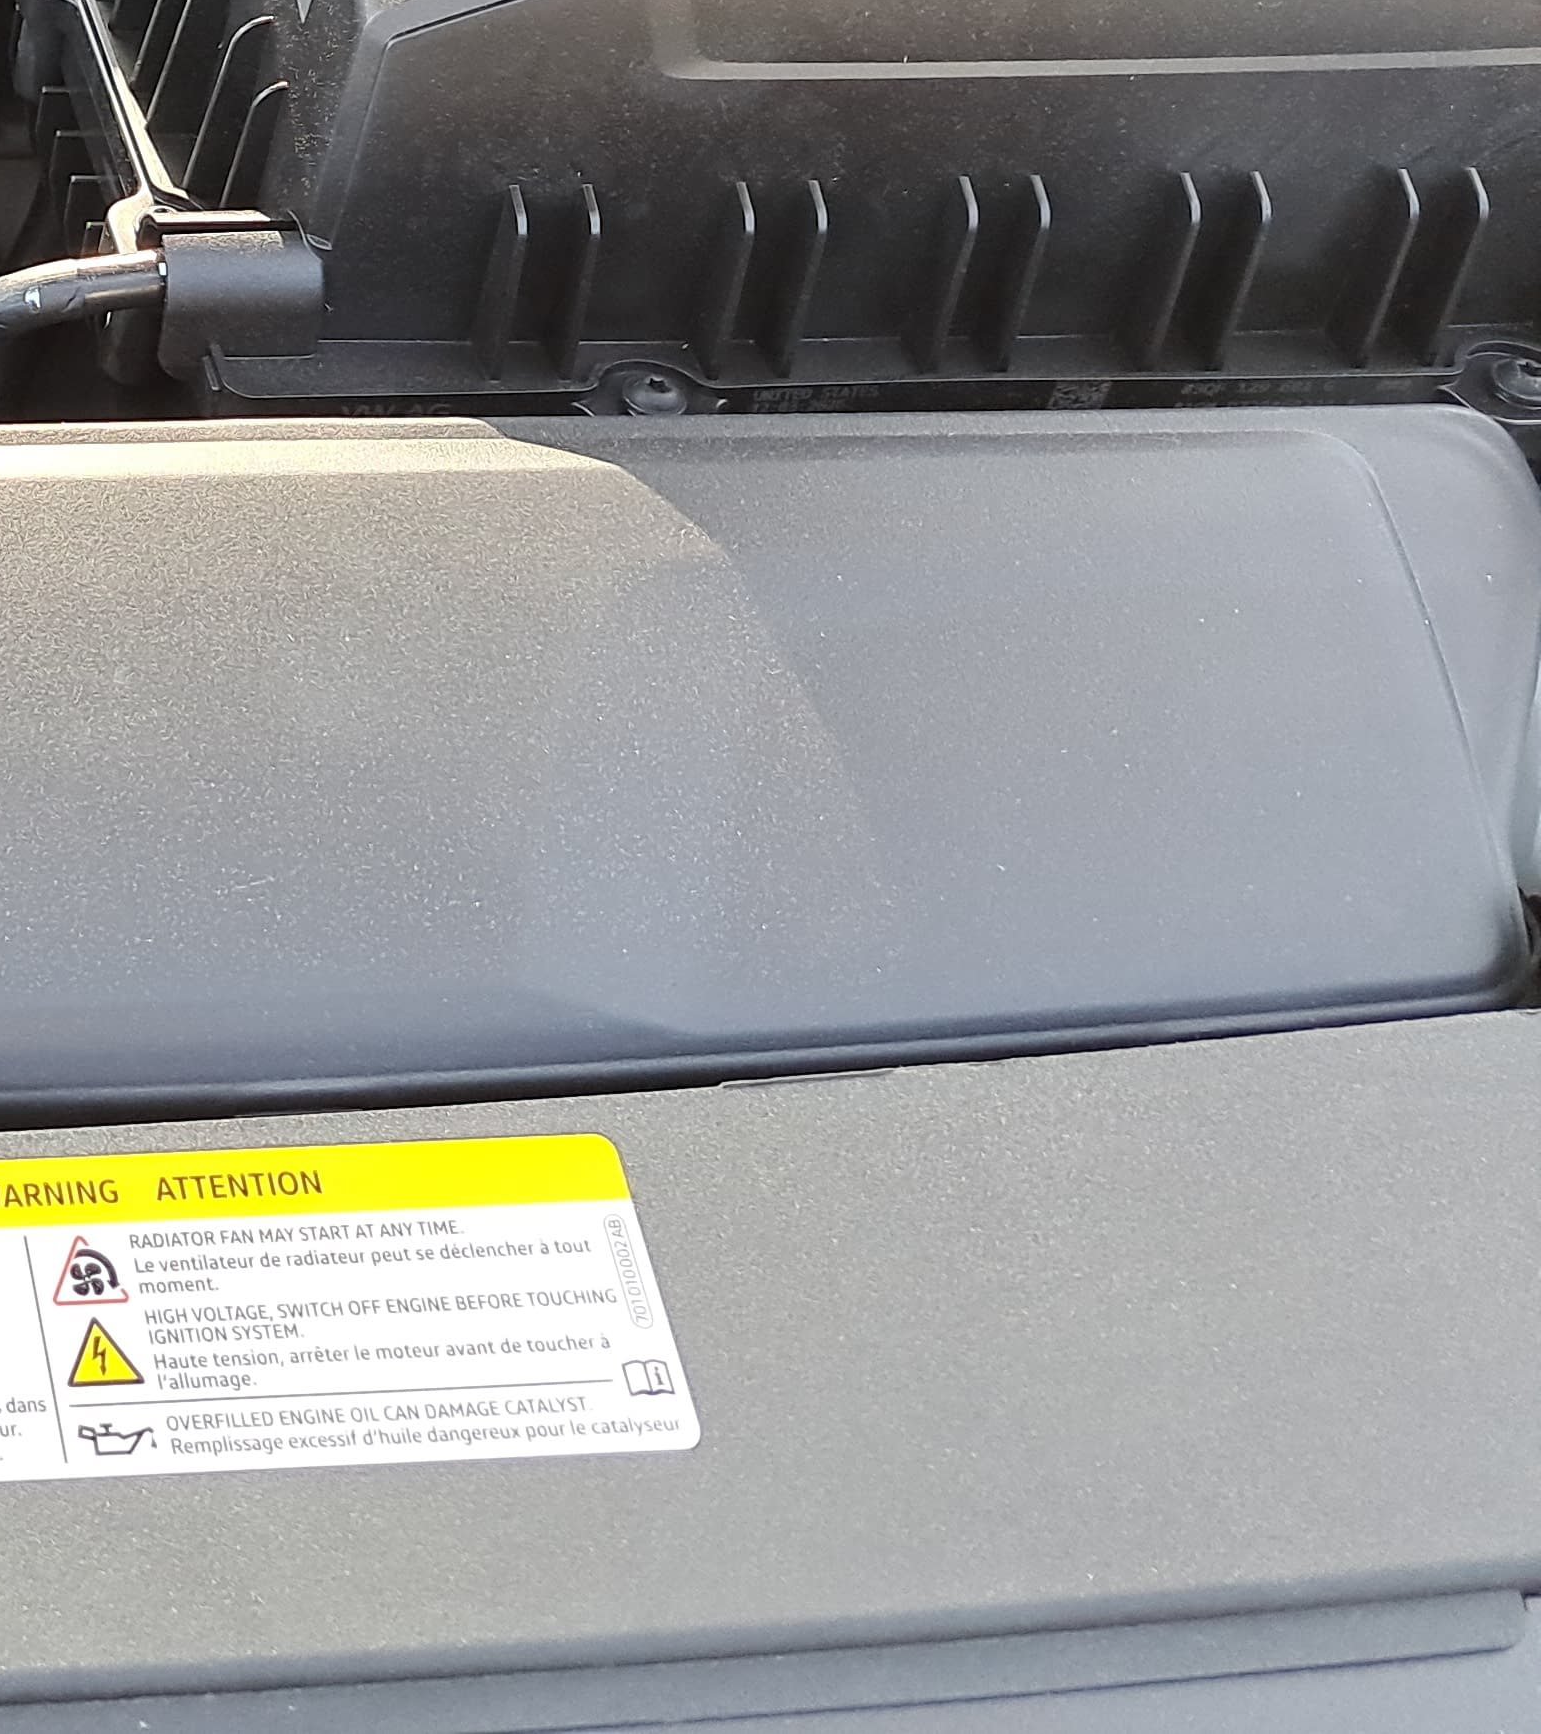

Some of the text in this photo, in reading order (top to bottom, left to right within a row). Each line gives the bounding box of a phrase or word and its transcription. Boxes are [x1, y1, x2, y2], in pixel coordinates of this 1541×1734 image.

[156, 1169, 323, 1202] ATTENTION
[128, 1219, 465, 1249] RADIATOR FAN MAY START AT ANY TIME.
[134, 1239, 592, 1274] Le ventilateur de radiateur peut se déclencher à tout
[139, 1278, 219, 1295] moment.
[144, 1288, 618, 1326] HIGH VOLTAGE, SWITCH OFF ENGINE BEFORE TOUCHING
[148, 1323, 305, 1345] IGNITION SYSTEM.
[154, 1332, 612, 1370] Haute tension, arrêter le moteur avant de toucher à
[157, 1372, 258, 1392] l'allumage.
[5, 1397, 47, 1414] dans
[166, 1411, 274, 1431] OVERFILLED
[279, 1408, 346, 1426] ENGINE
[350, 1406, 380, 1423] OIL
[383, 1404, 420, 1421] CAN
[425, 1400, 501, 1419] DAMAGE
[170, 1435, 283, 1456] Remplissage
[288, 1430, 357, 1449] excessif
[363, 1427, 423, 1446] d'huile
[427, 1423, 520, 1446] dangereux
[525, 1422, 566, 1442] pour
[569, 1419, 587, 1436] le
